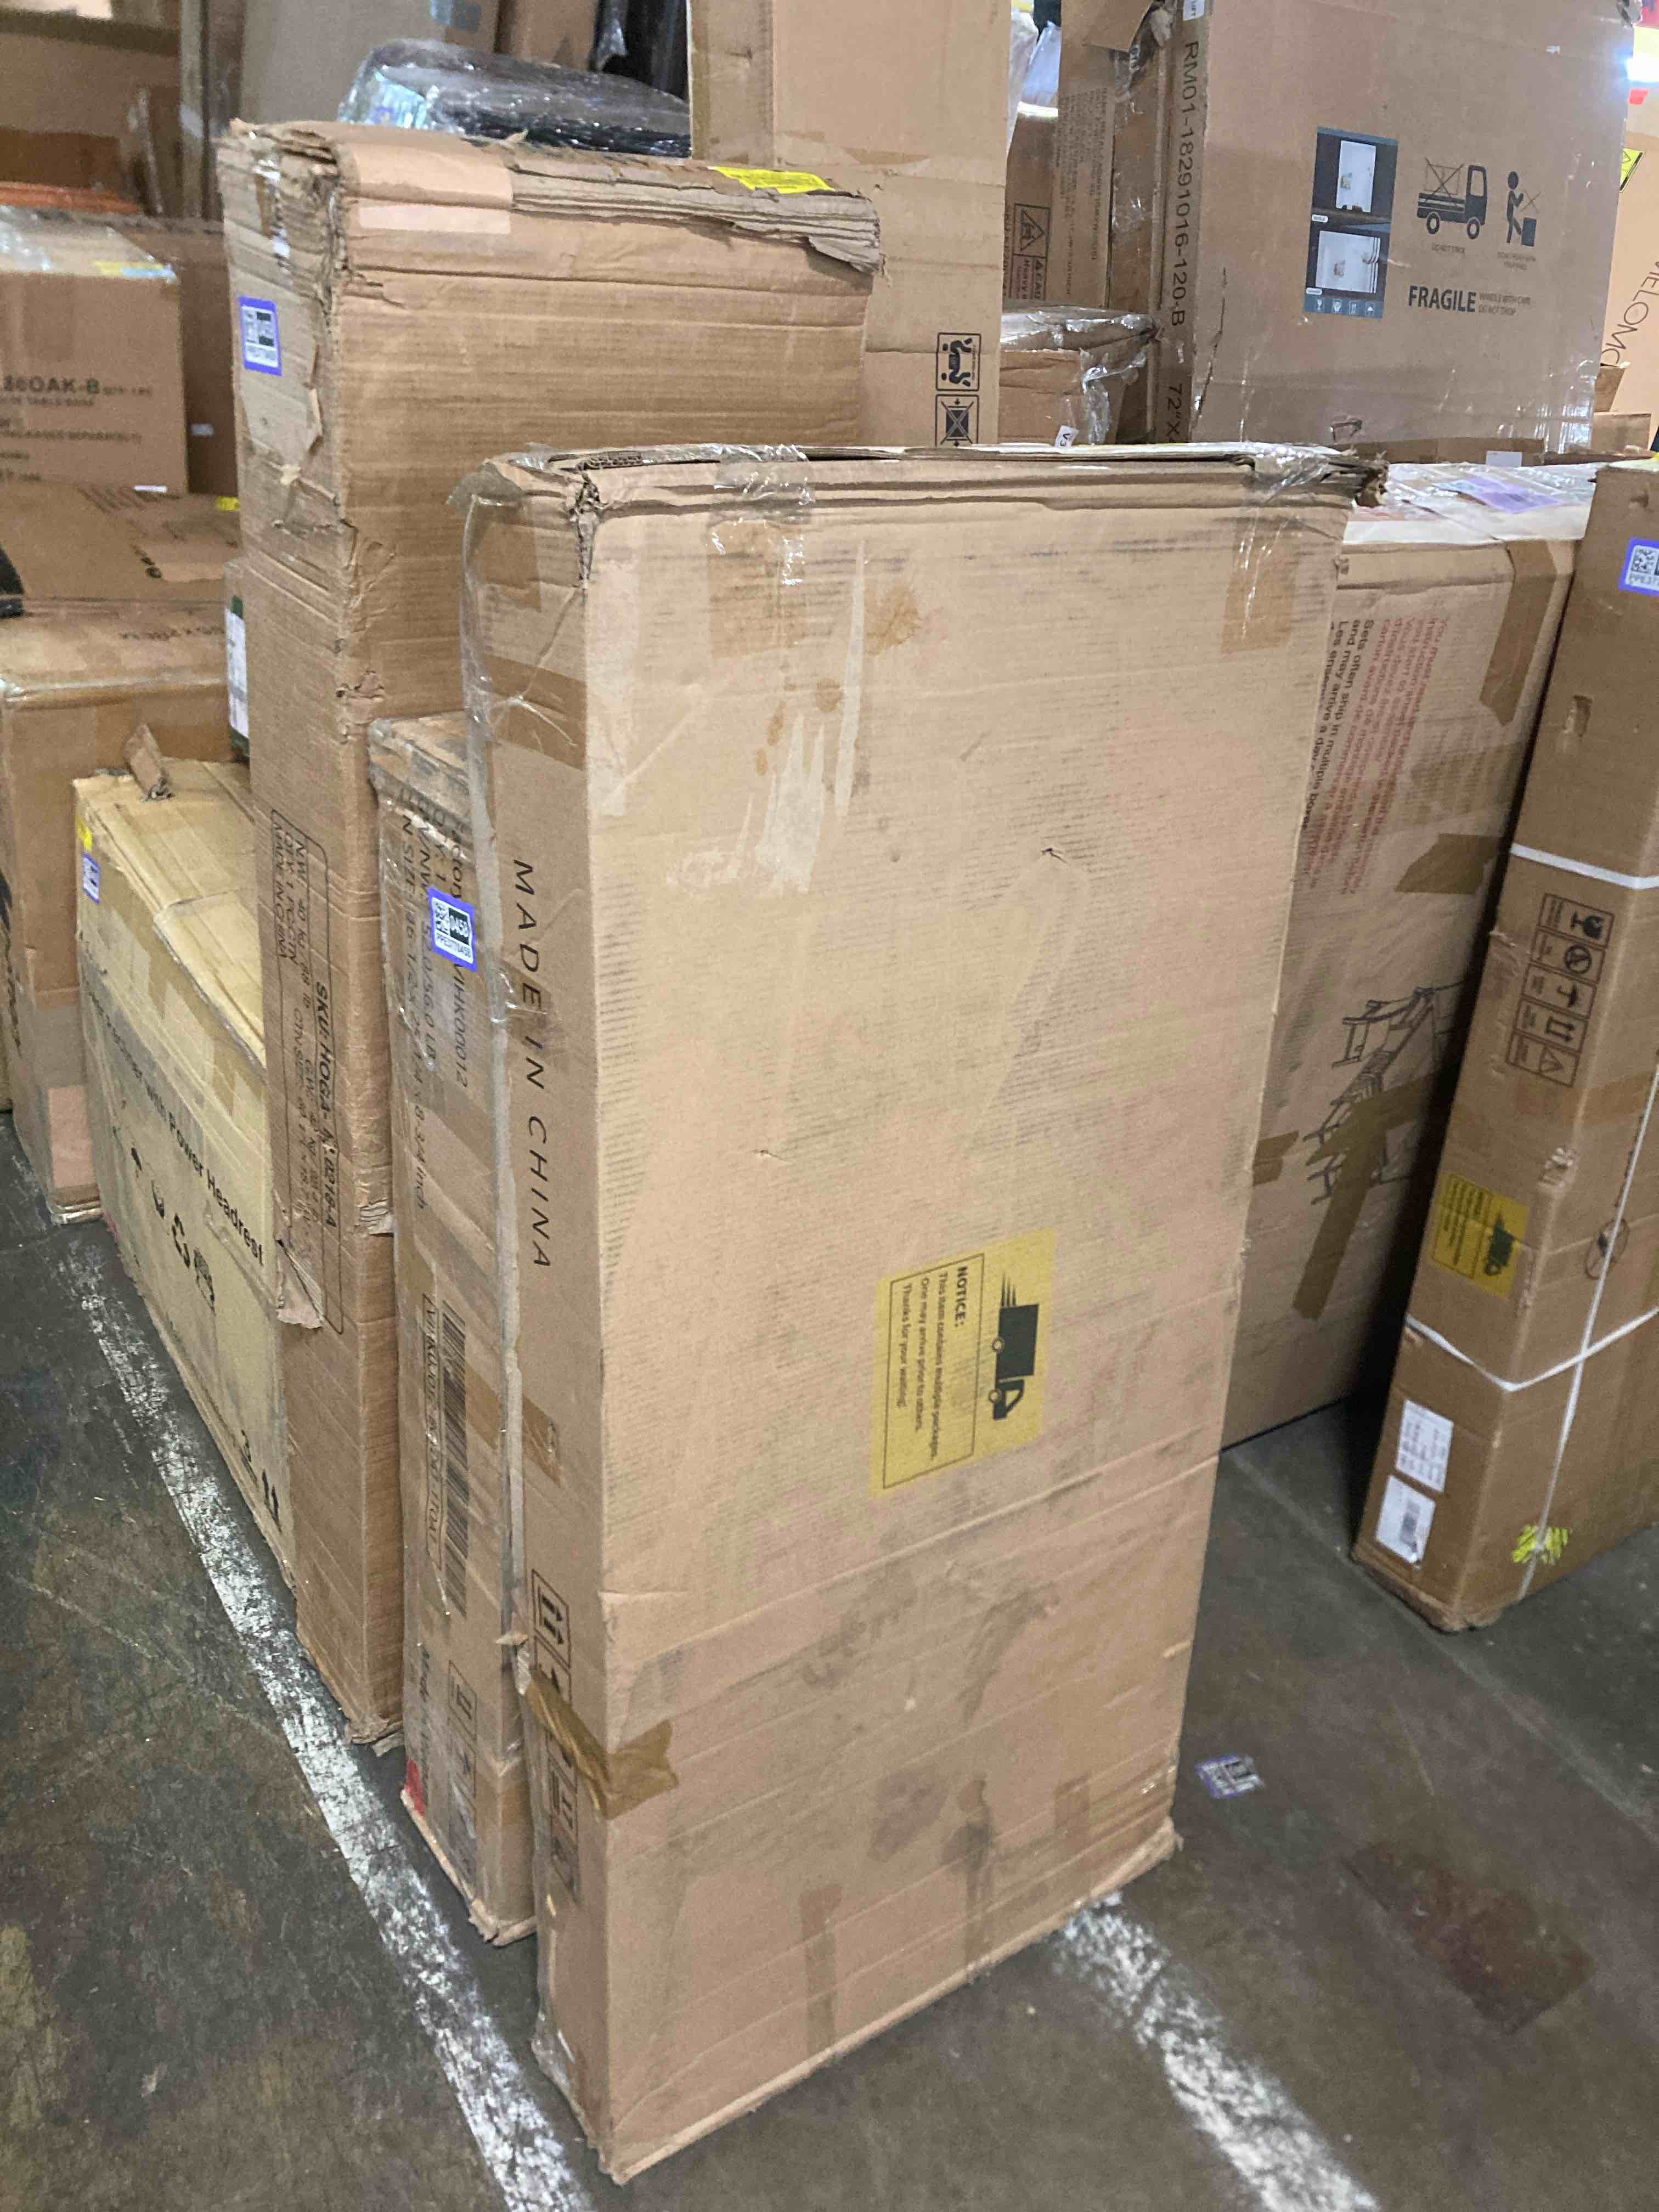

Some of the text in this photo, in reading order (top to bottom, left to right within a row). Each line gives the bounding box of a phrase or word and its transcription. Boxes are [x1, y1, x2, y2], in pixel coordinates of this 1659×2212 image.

[1171, 42, 1200, 326] RM01-18291016-120-B
[1408, 285, 1476, 313] FRAGILE
[1332, 620, 1349, 646] Les
[1345, 619, 1364, 645] and
[1356, 619, 1375, 650] Sets
[1334, 651, 1352, 678] may
[1344, 655, 1364, 688] often
[1322, 684, 1342, 721] arrive
[1332, 693, 1352, 720] ship
[1329, 725, 1341, 735] in
[1311, 740, 1336, 789] multiple
[316, 981, 330, 1039] SKU:
[514, 859, 551, 1268] MADE IN CHINA
[168, 1111, 204, 1177] Power
[207, 1167, 263, 1266] Headrest
[902, 1284, 912, 1322] Thanks
[955, 1266, 968, 1328] NOTICE:
[901, 1324, 911, 1340] for
